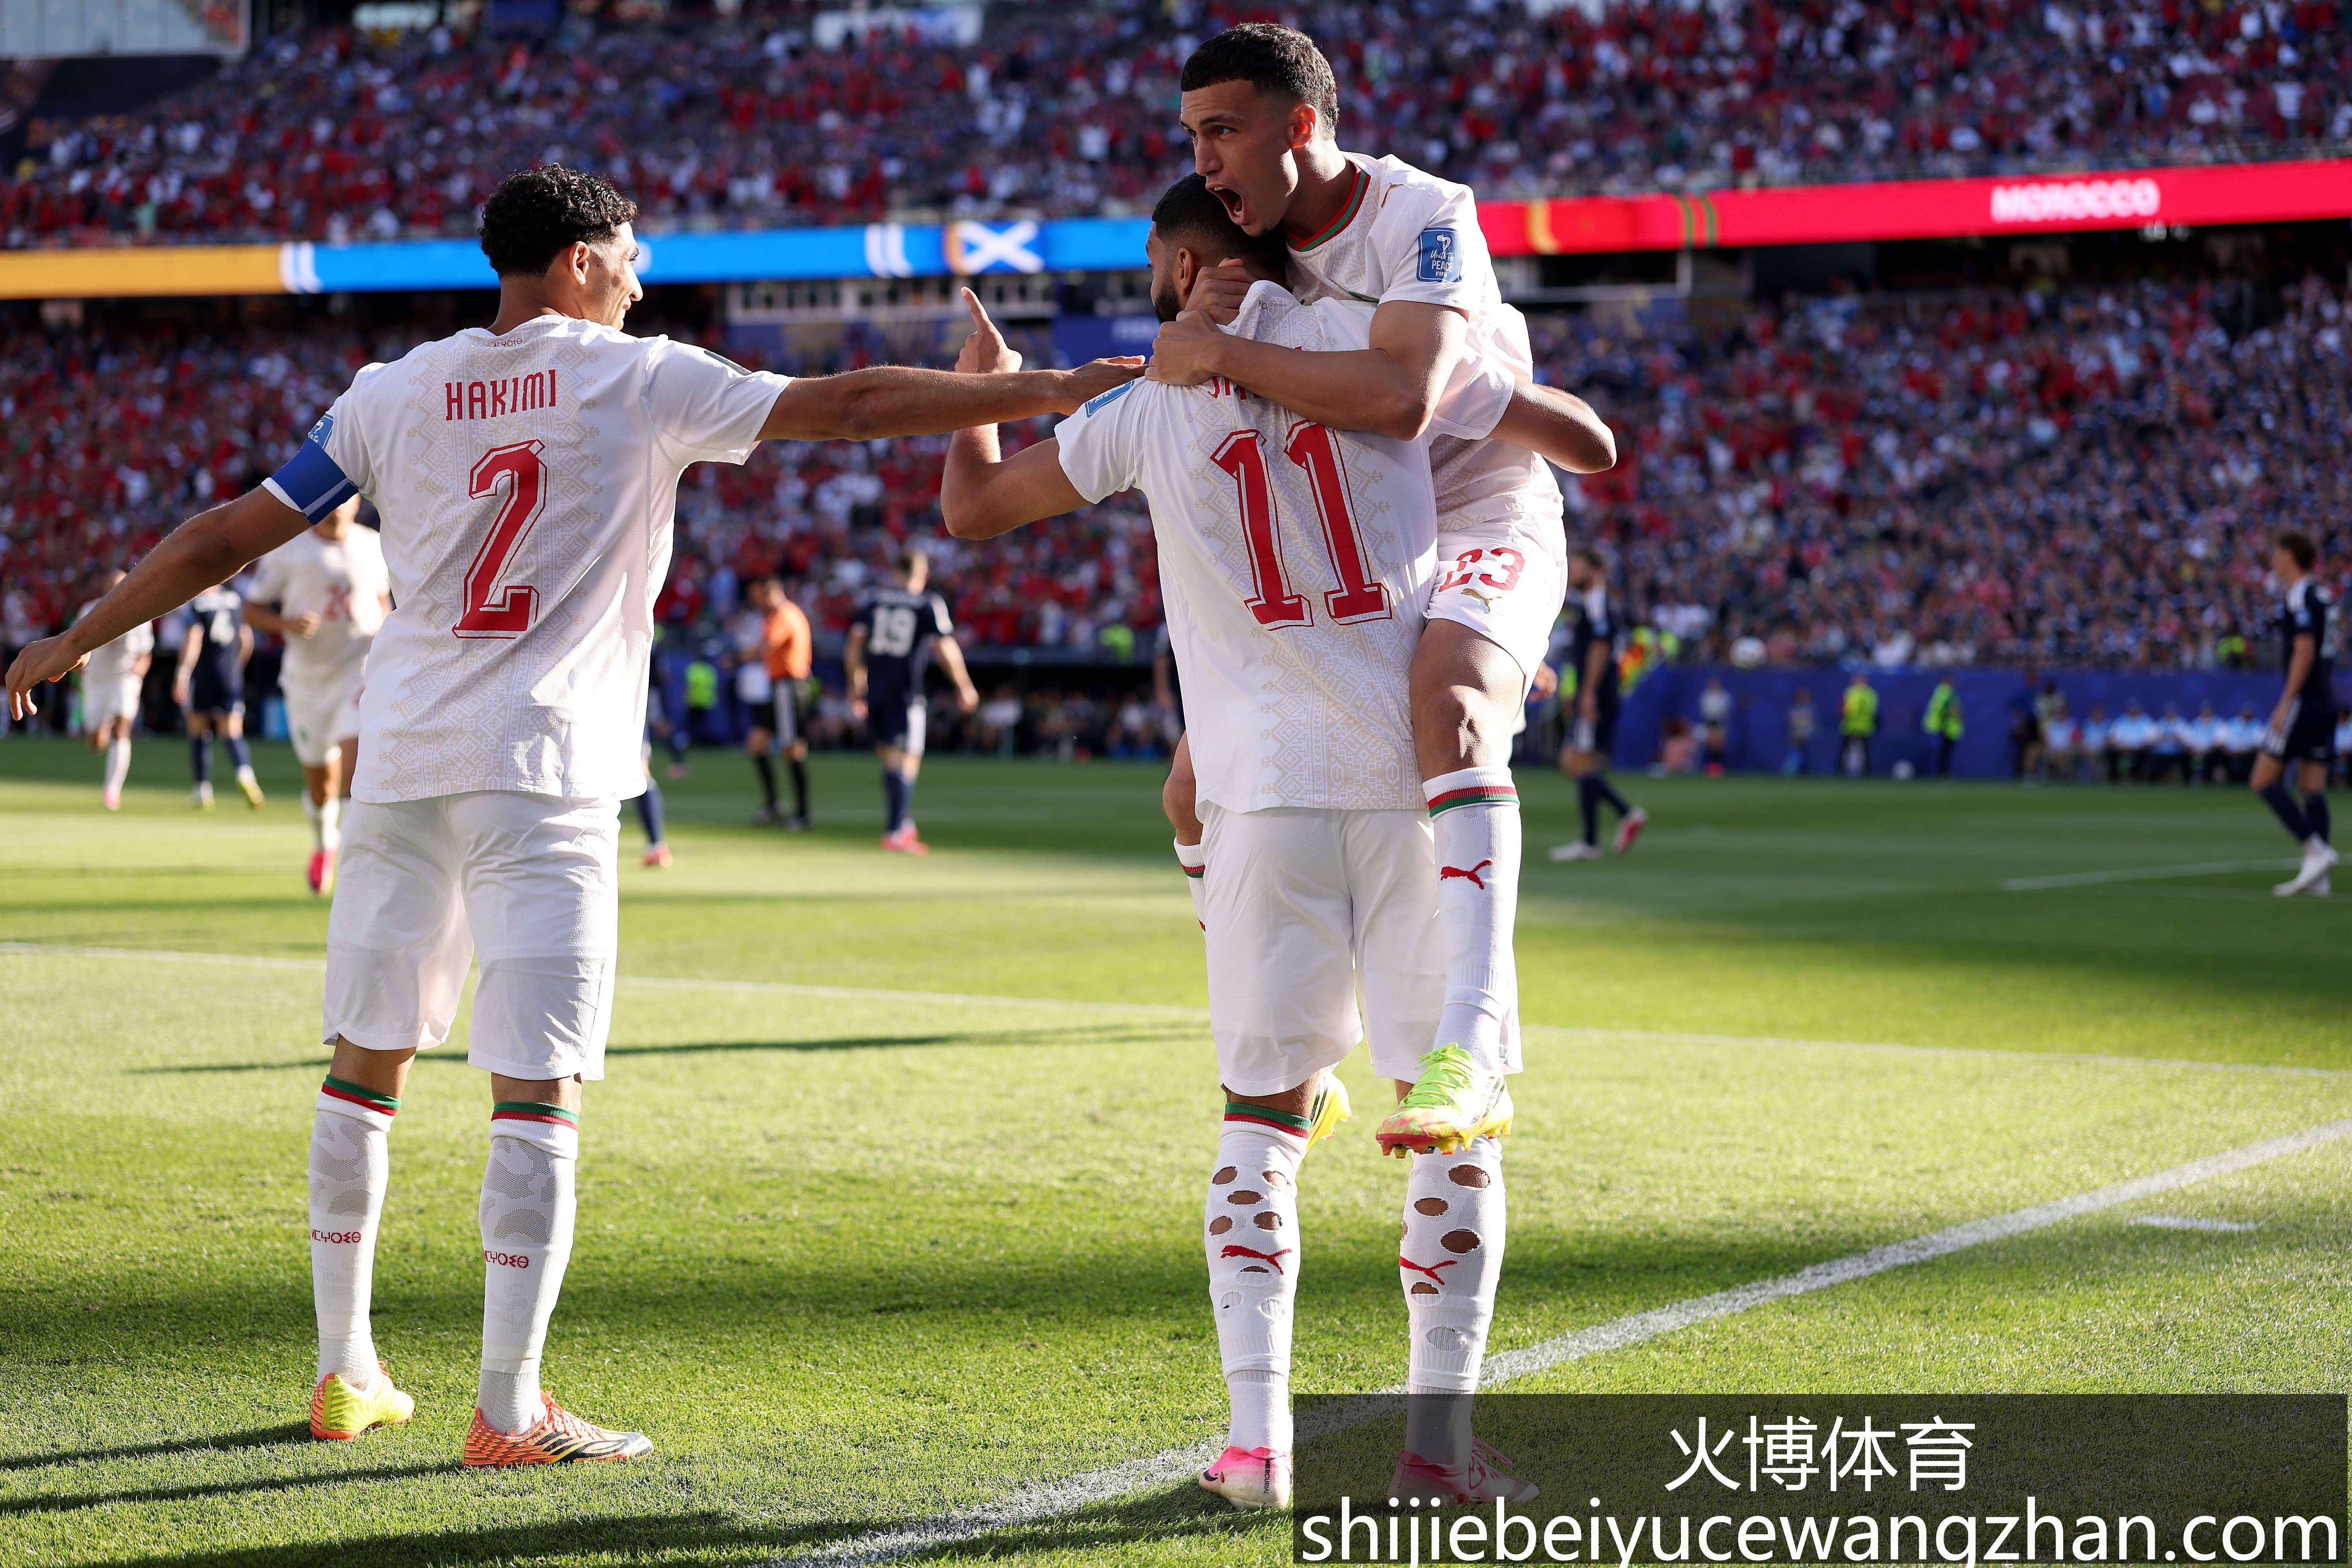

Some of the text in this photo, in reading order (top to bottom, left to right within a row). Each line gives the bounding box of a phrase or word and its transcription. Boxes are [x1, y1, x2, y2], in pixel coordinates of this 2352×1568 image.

[1991, 179, 2160, 221] MOROCCO
[1431, 260, 1453, 272] PEACE
[445, 369, 556, 421] HAKIMI
[452, 439, 547, 640] 2
[1209, 419, 1392, 631] 11
[1438, 547, 1526, 592] 23
